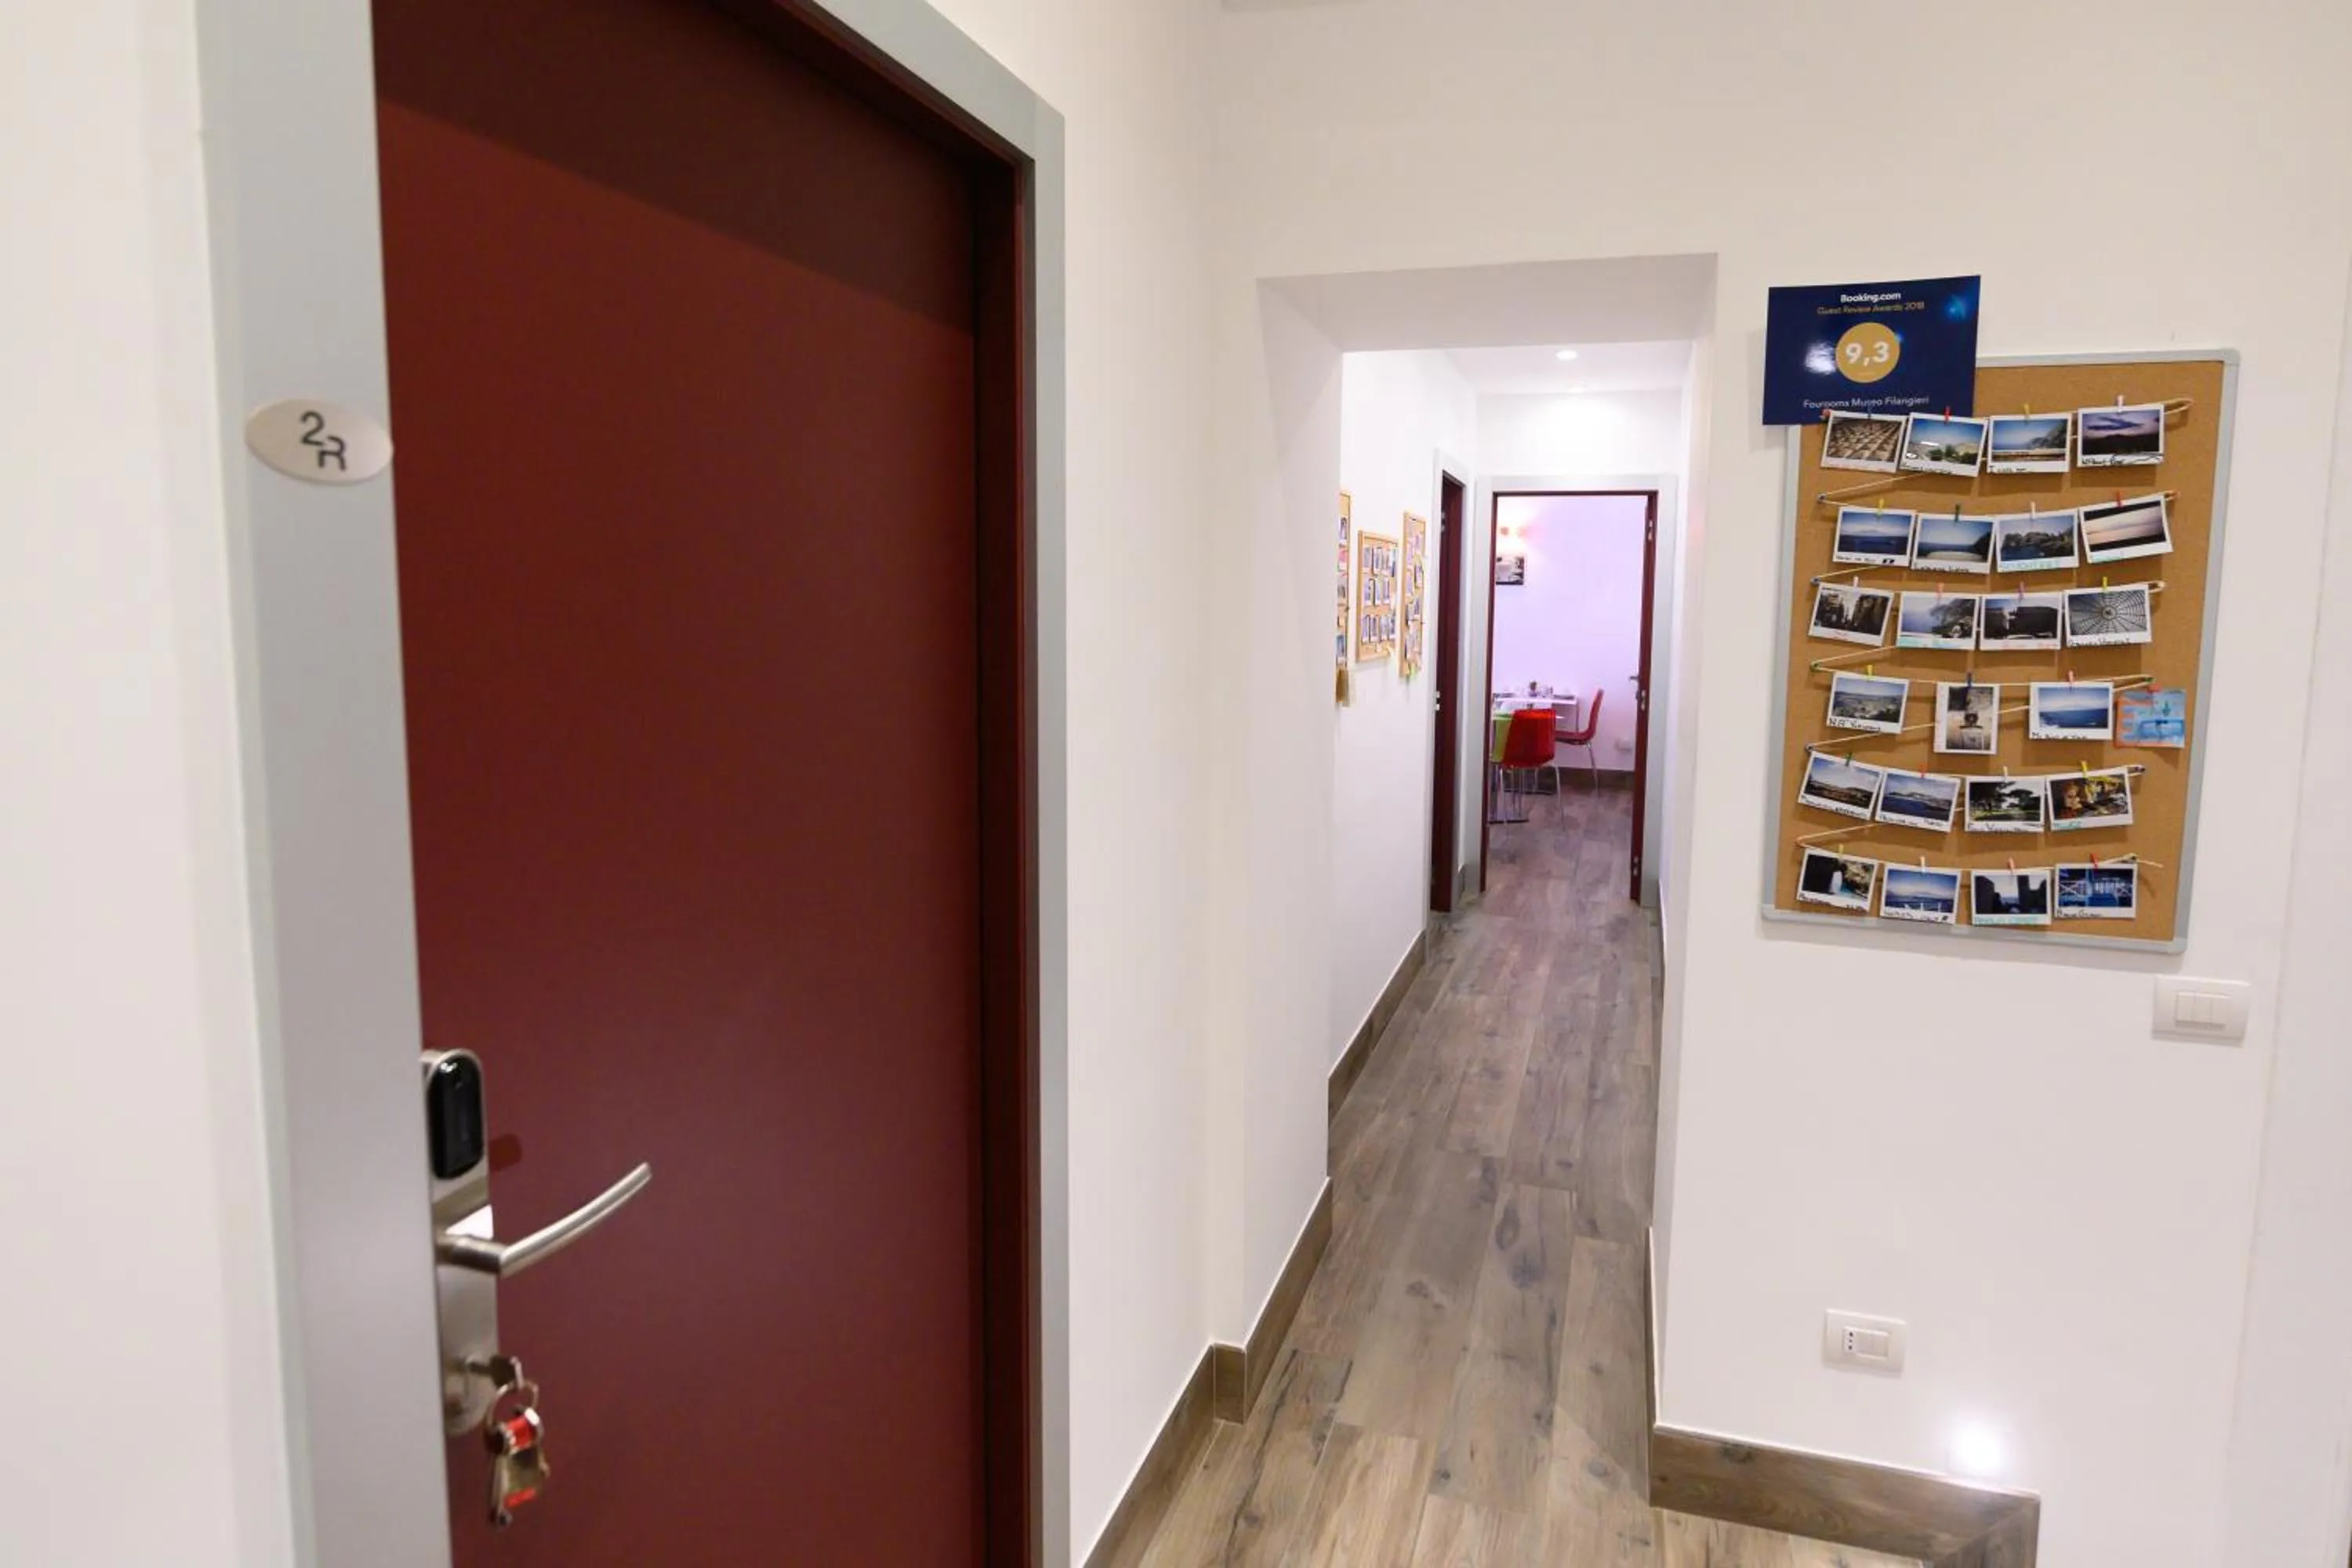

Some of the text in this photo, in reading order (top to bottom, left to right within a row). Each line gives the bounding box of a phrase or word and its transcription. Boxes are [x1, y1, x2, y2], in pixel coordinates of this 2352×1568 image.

[1840, 292, 1901, 303] Booking.com
[1817, 306, 1842, 314] Guest
[1872, 303, 1904, 313] Awards
[1846, 340, 1890, 366] 9,3
[1803, 398, 1849, 408] Fourooms
[1885, 395, 1929, 406] Filangieri
